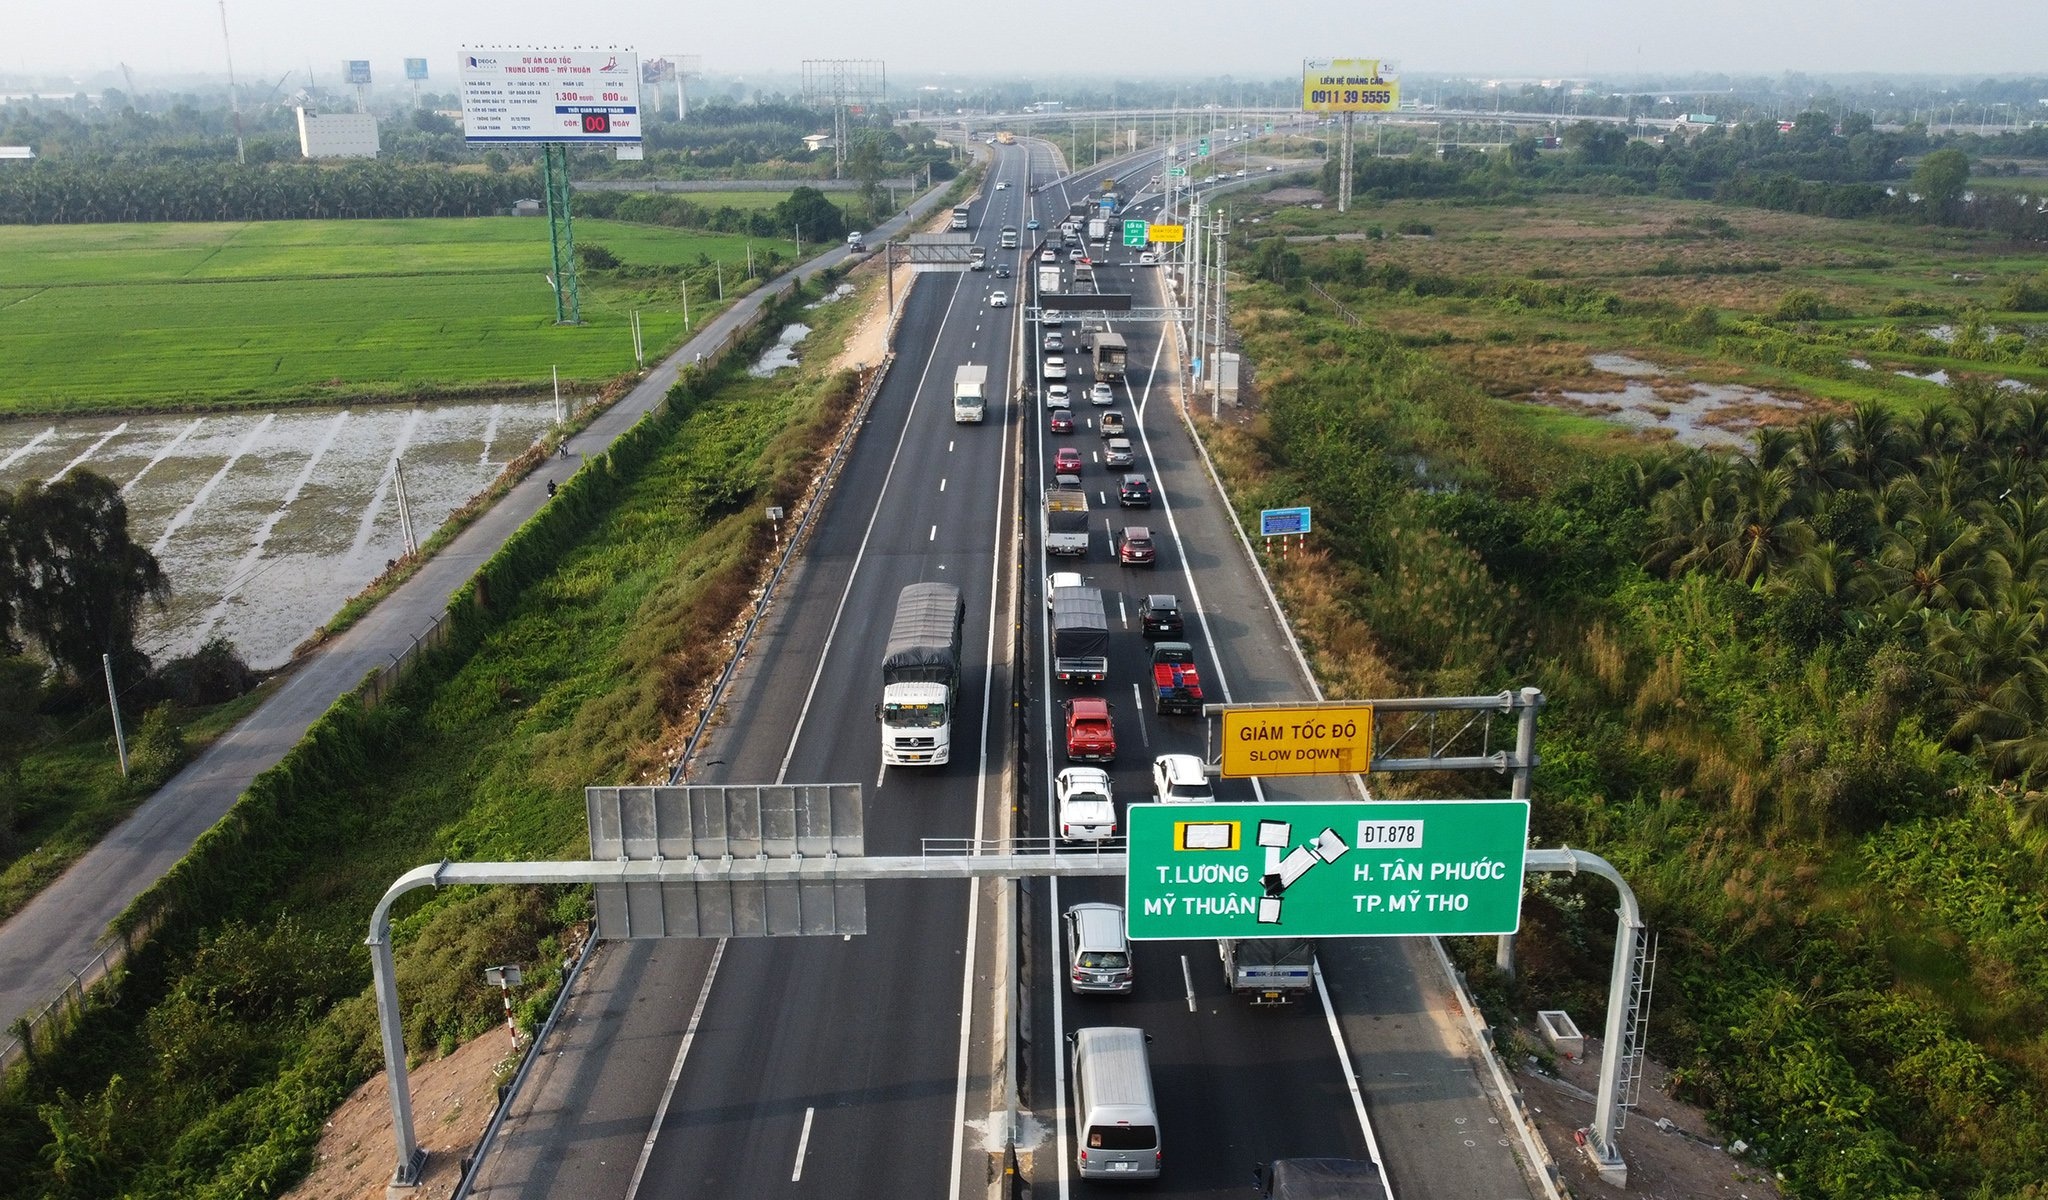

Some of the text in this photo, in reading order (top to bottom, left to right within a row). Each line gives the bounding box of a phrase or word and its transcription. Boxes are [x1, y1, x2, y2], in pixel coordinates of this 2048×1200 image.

[1320, 75, 1383, 86] LIÊN HỆ QUẢNG CÁO
[556, 92, 578, 101] 1.300
[602, 93, 618, 101] 800
[1312, 90, 1390, 103] 0911 39 5555
[586, 116, 605, 132] 00
[1240, 717, 1357, 742] GIẢM TỐC ĐỘ
[1249, 748, 1340, 762] SLOW DOWN
[1364, 824, 1415, 844] ĐT.878
[1156, 864, 1249, 884] T.LƯƠNG
[1353, 856, 1506, 882] H. TÂN PHƯỚC
[1144, 892, 1256, 919] MỸ THUẬN
[1426, 894, 1470, 912] THO
